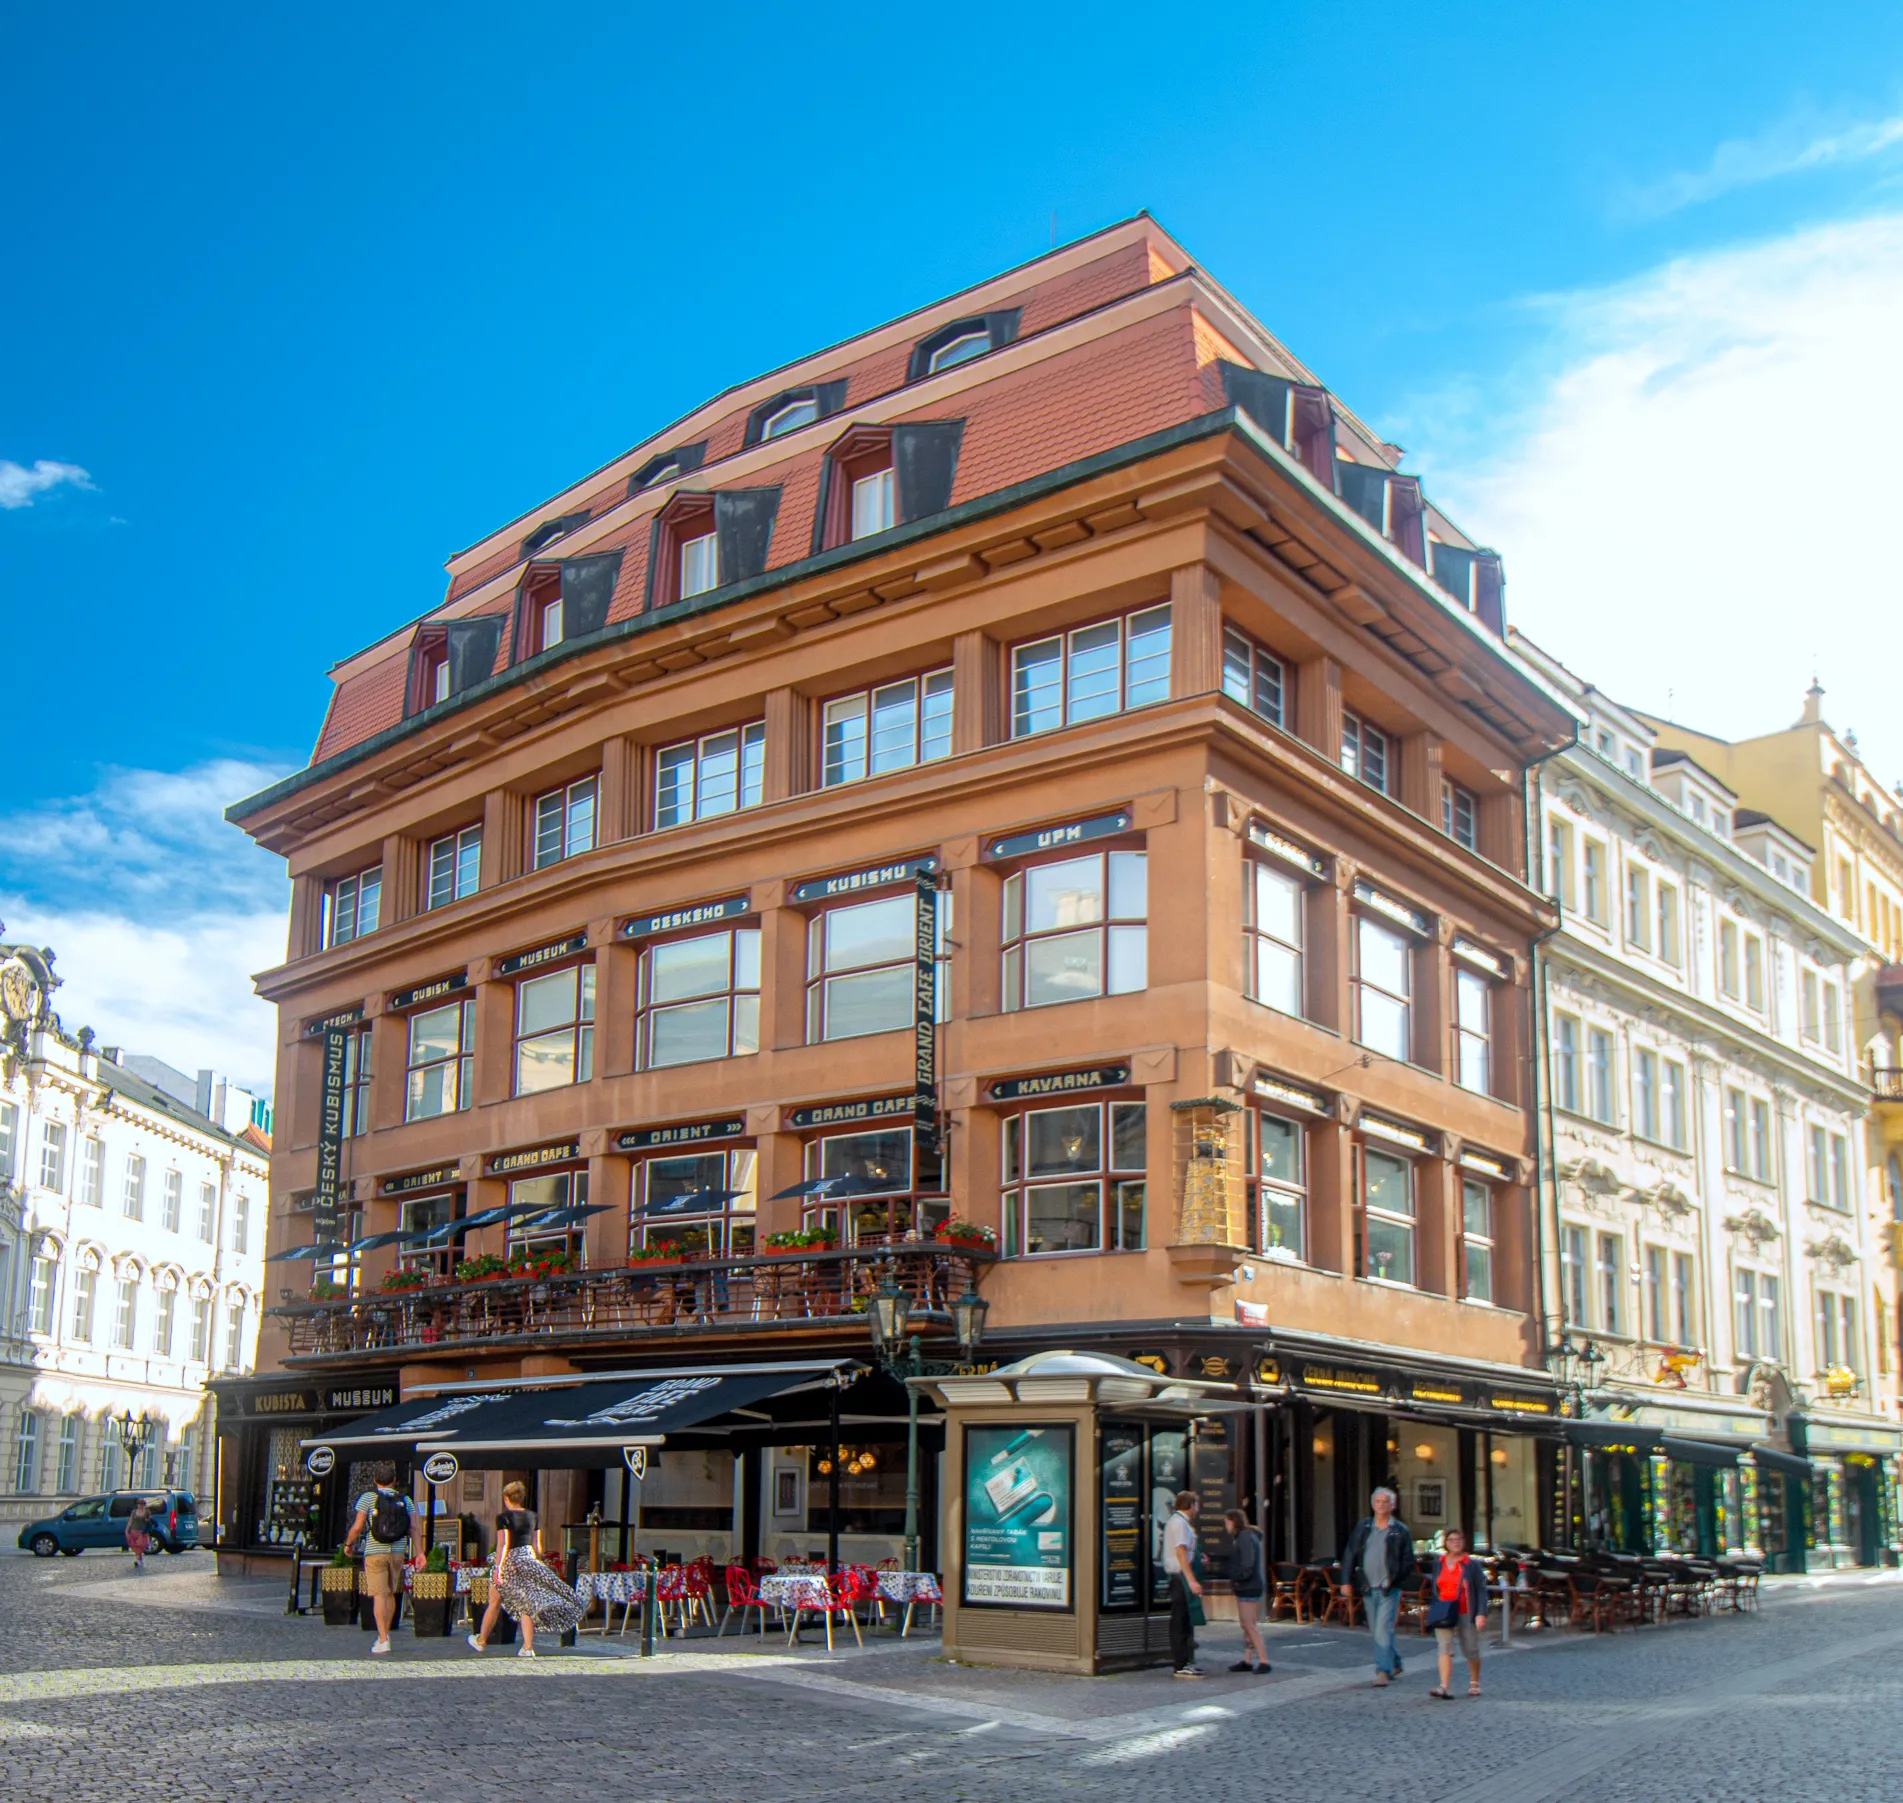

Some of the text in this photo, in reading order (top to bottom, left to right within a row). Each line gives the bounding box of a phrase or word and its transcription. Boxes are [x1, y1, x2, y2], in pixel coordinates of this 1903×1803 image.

[1037, 825, 1082, 847] UPM
[827, 865, 907, 893] KUBISMU
[519, 942, 568, 967] MUSEUM
[412, 980, 450, 1002] CUBISM
[917, 898, 935, 1085] GRAND CAFE ORIENT
[325, 1034, 343, 1135] KUBISMUS
[811, 1096, 917, 1123] GRAND CAFE
[651, 1124, 712, 1144] ORIENT
[503, 1145, 570, 1169] GRAND CAFE
[403, 1170, 443, 1189] ORIENT
[255, 1389, 393, 1413] KUBISTA MUSEUM
